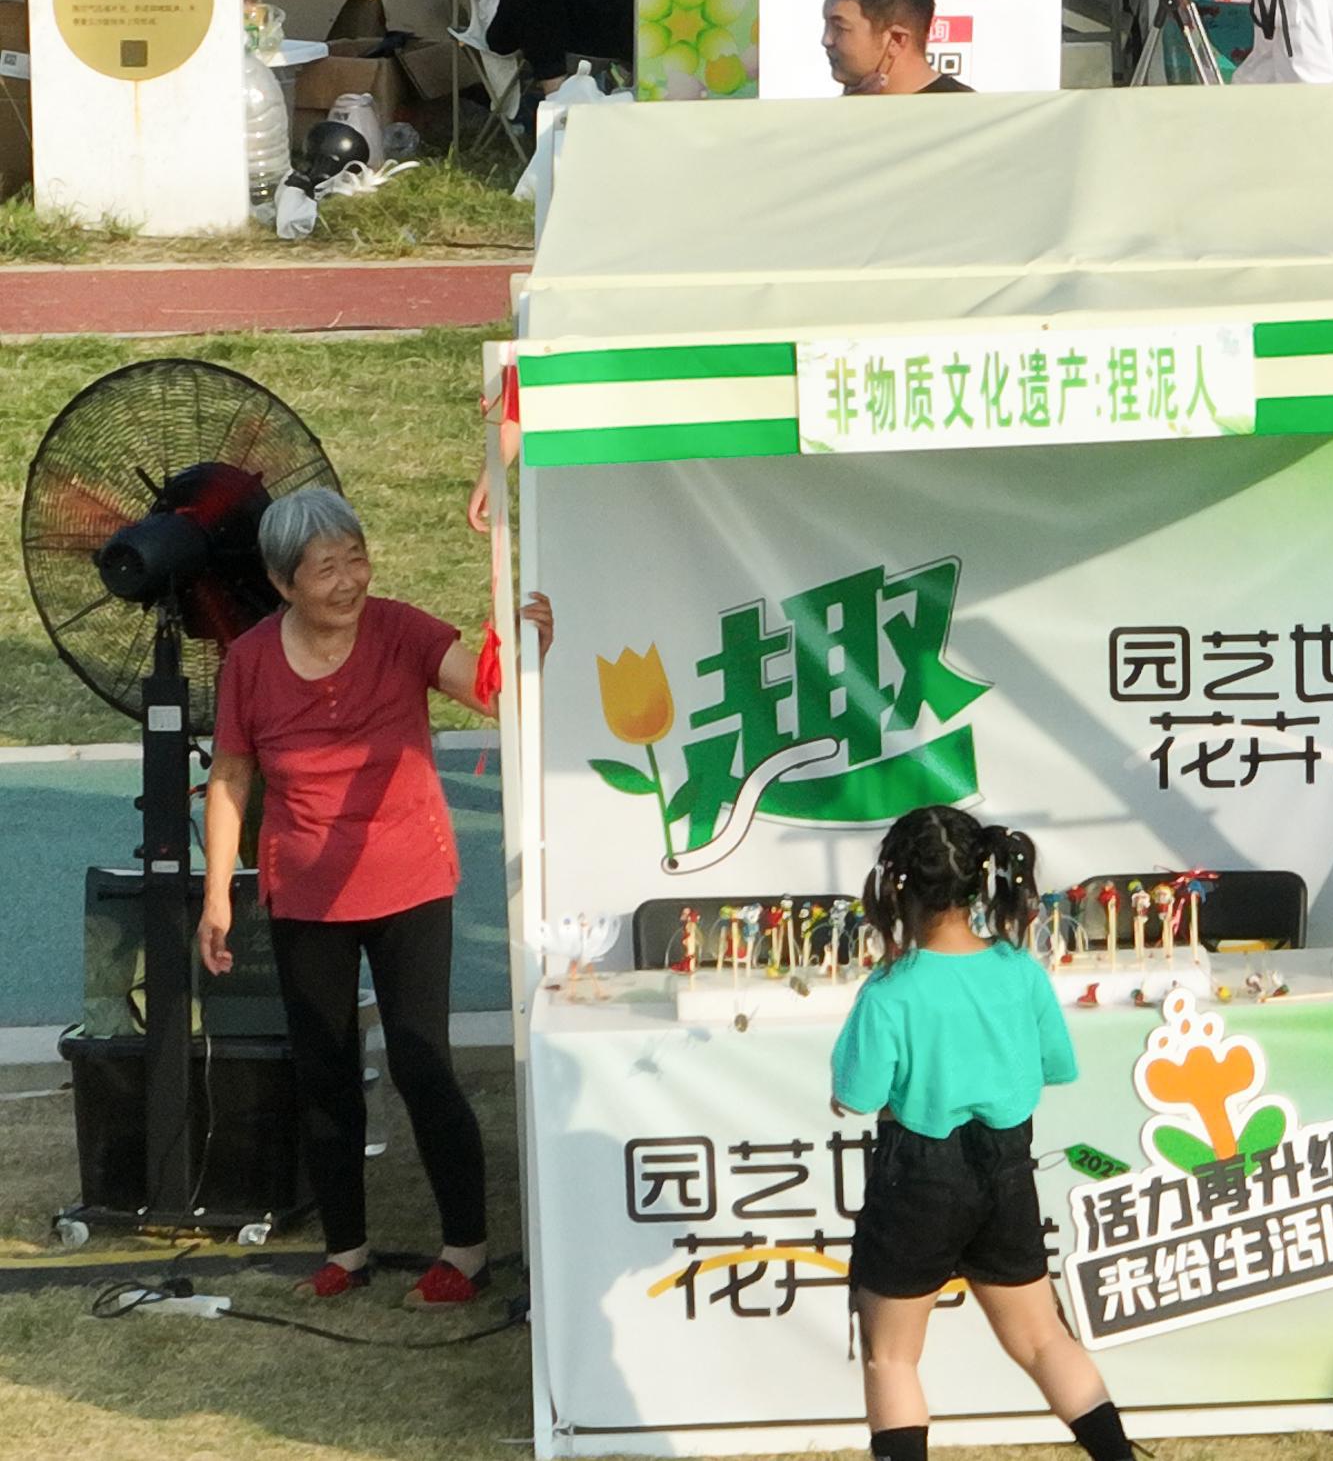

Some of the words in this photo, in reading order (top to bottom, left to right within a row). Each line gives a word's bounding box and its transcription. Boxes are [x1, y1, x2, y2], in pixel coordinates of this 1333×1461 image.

[825, 345, 1218, 435] 非物质文化遗产:捏泥人
[666, 556, 995, 851] 趣
